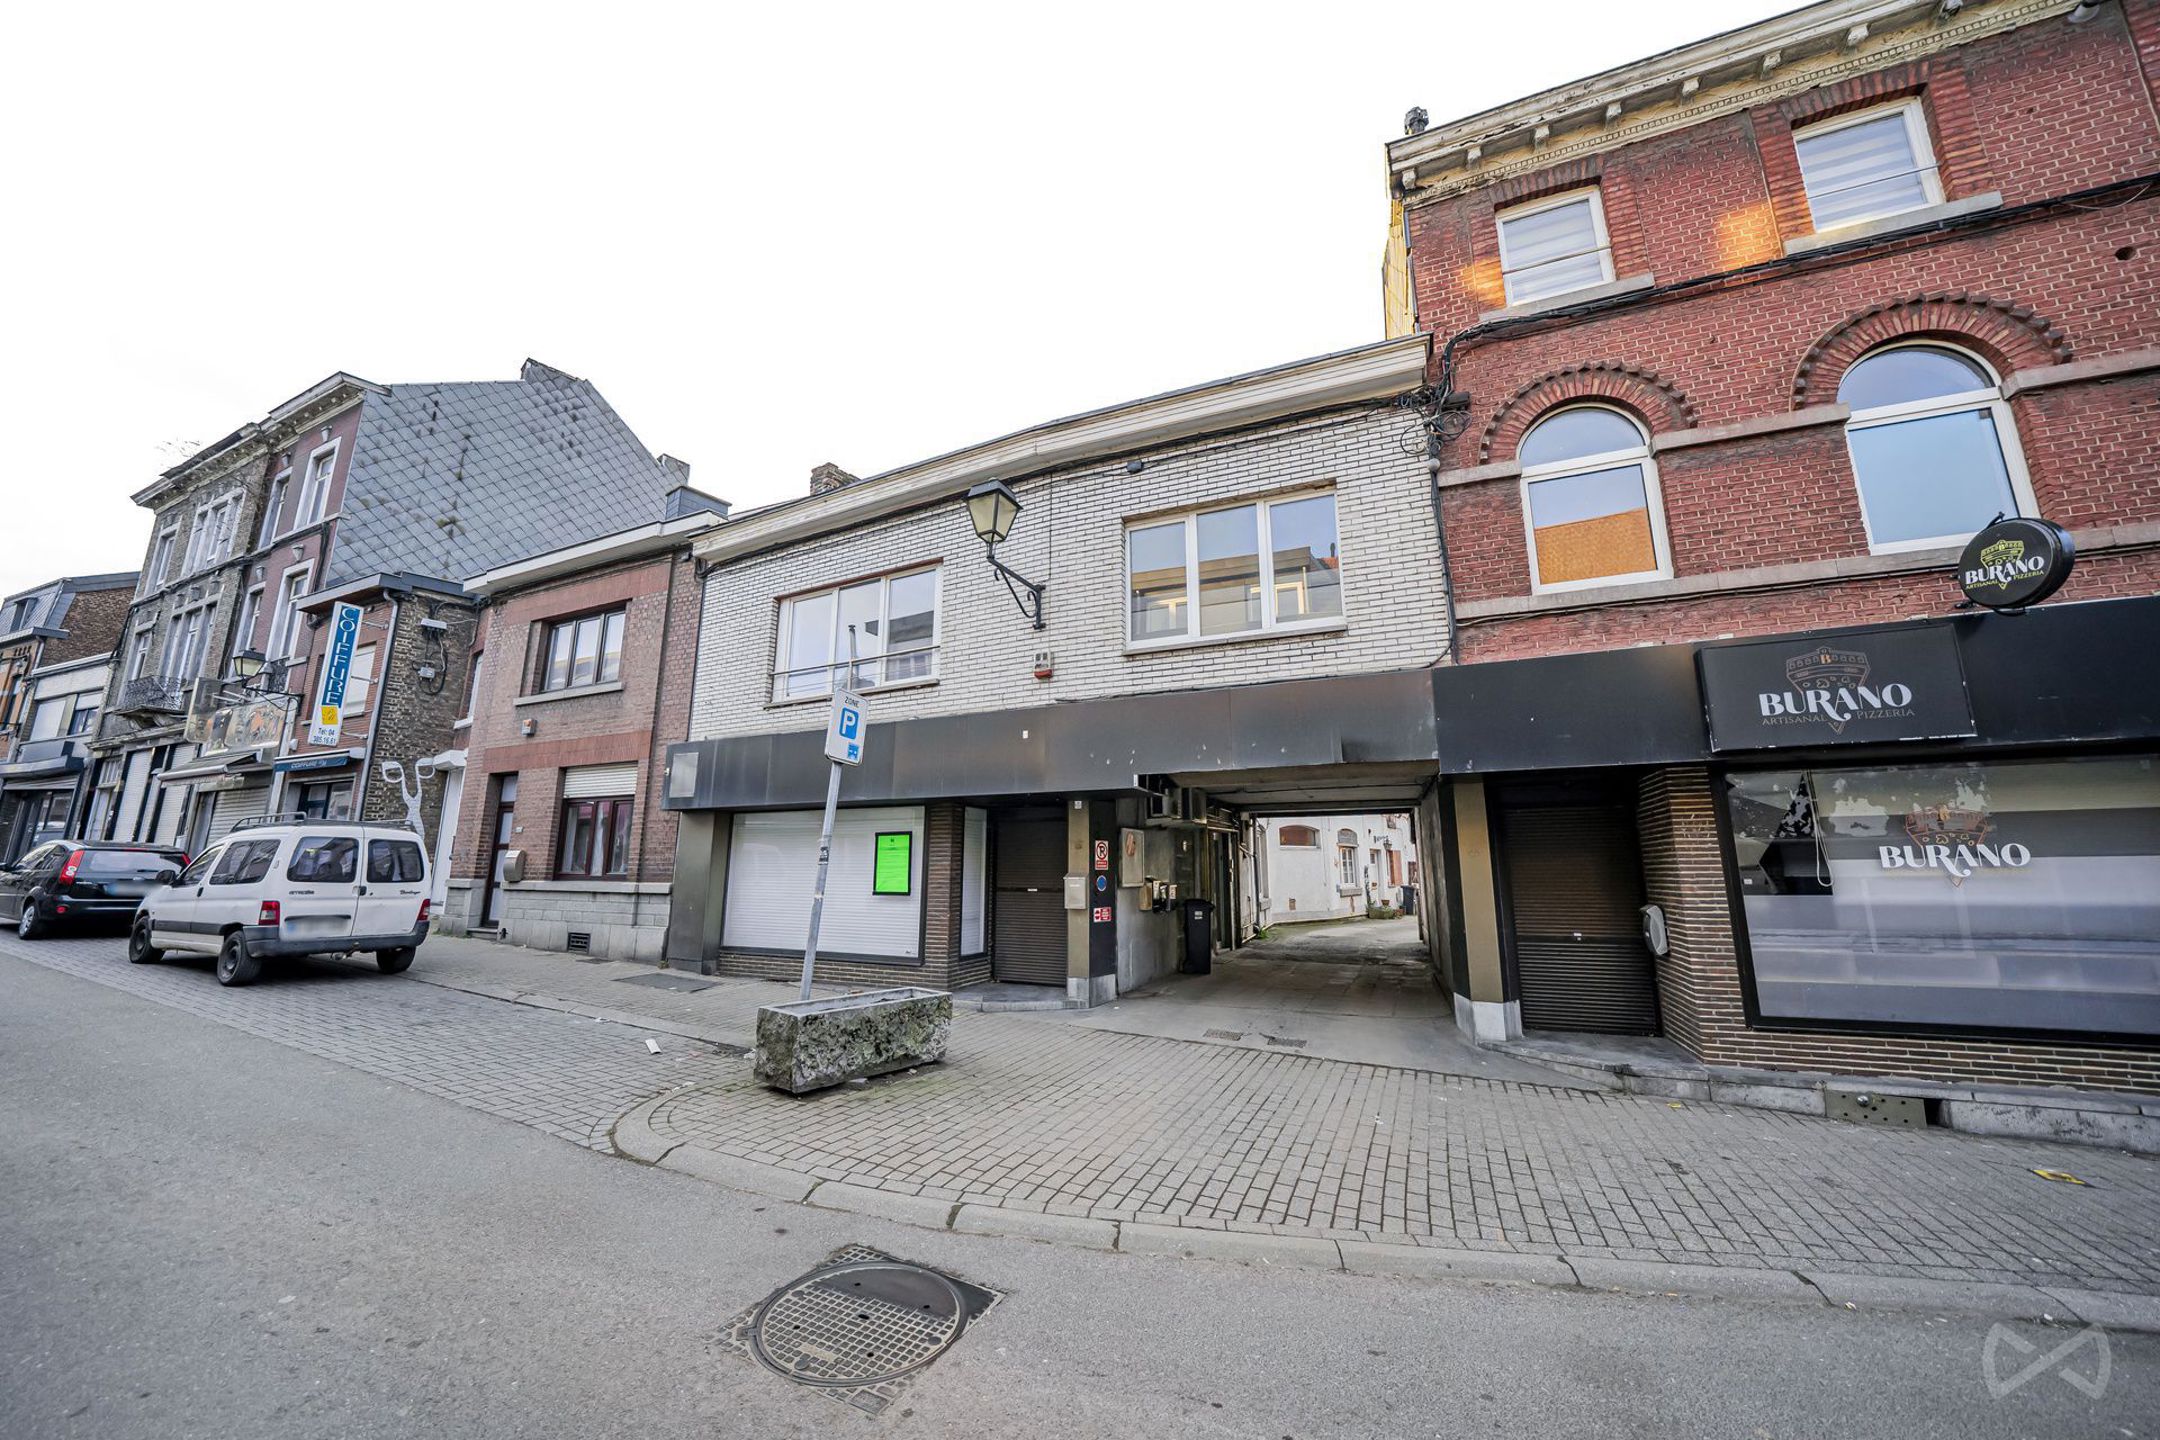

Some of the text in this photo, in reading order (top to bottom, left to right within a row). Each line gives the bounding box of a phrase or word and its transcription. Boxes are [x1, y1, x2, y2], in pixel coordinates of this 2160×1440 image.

[1965, 556, 2044, 583] BURANO
[1966, 570, 2044, 590] ARTISANAL PIZZERIA
[325, 606, 356, 705] COIFFURE
[1759, 683, 1912, 721] BURANO
[842, 710, 855, 734] P
[1762, 708, 1915, 726] ARTISANAL PIZZERIA
[1879, 843, 2031, 877] BURANO
